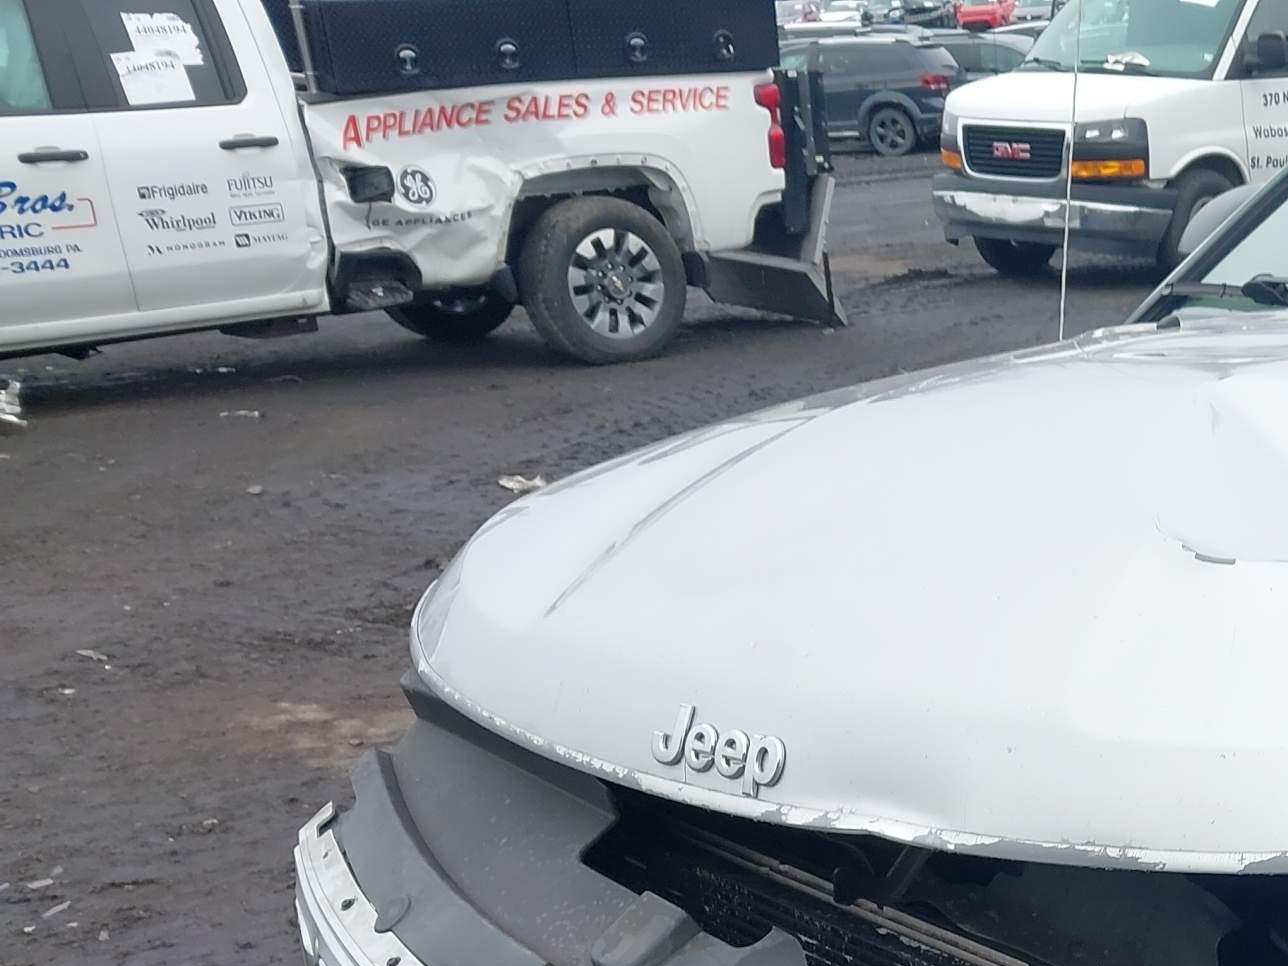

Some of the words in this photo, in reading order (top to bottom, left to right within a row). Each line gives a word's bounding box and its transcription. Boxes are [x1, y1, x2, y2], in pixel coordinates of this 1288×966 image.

[1263, 92, 1280, 107] 370
[341, 101, 493, 151] APPLIANCE
[503, 92, 590, 123] SALES
[601, 92, 617, 117] &
[630, 86, 730, 114] SERVICE
[992, 141, 1031, 160] GMC
[1266, 154, 1288, 169] Paul
[151, 183, 208, 200] Frigidaire
[227, 176, 273, 191] FUJITSU
[145, 212, 216, 231] Whirlpool
[233, 207, 281, 222] VIKING
[651, 703, 786, 799] Jeep
